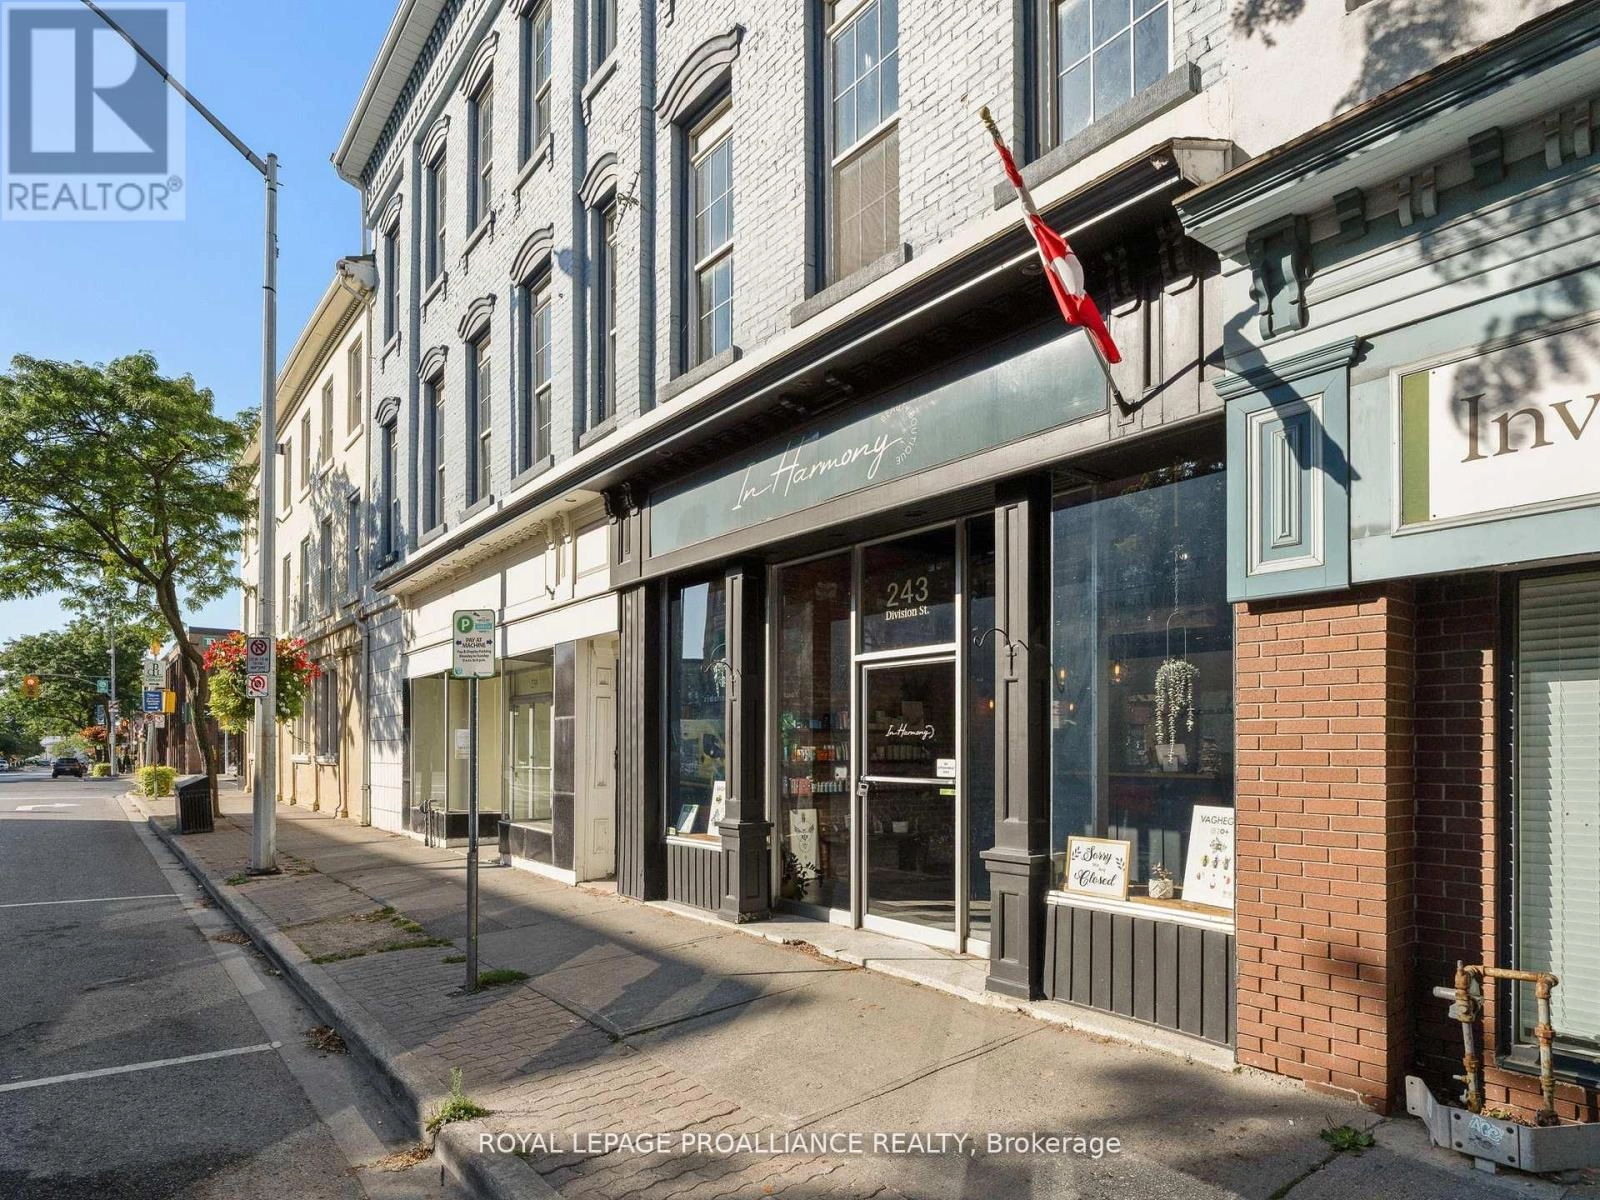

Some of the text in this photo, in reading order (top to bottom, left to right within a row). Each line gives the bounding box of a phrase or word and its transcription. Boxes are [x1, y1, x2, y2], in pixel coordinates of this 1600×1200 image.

[732, 435, 902, 510] In Harmony
[886, 576, 929, 607] 243
[885, 606, 930, 621] Division St.
[1081, 845, 1112, 864] Sorry
[1074, 869, 1116, 887] Closed
